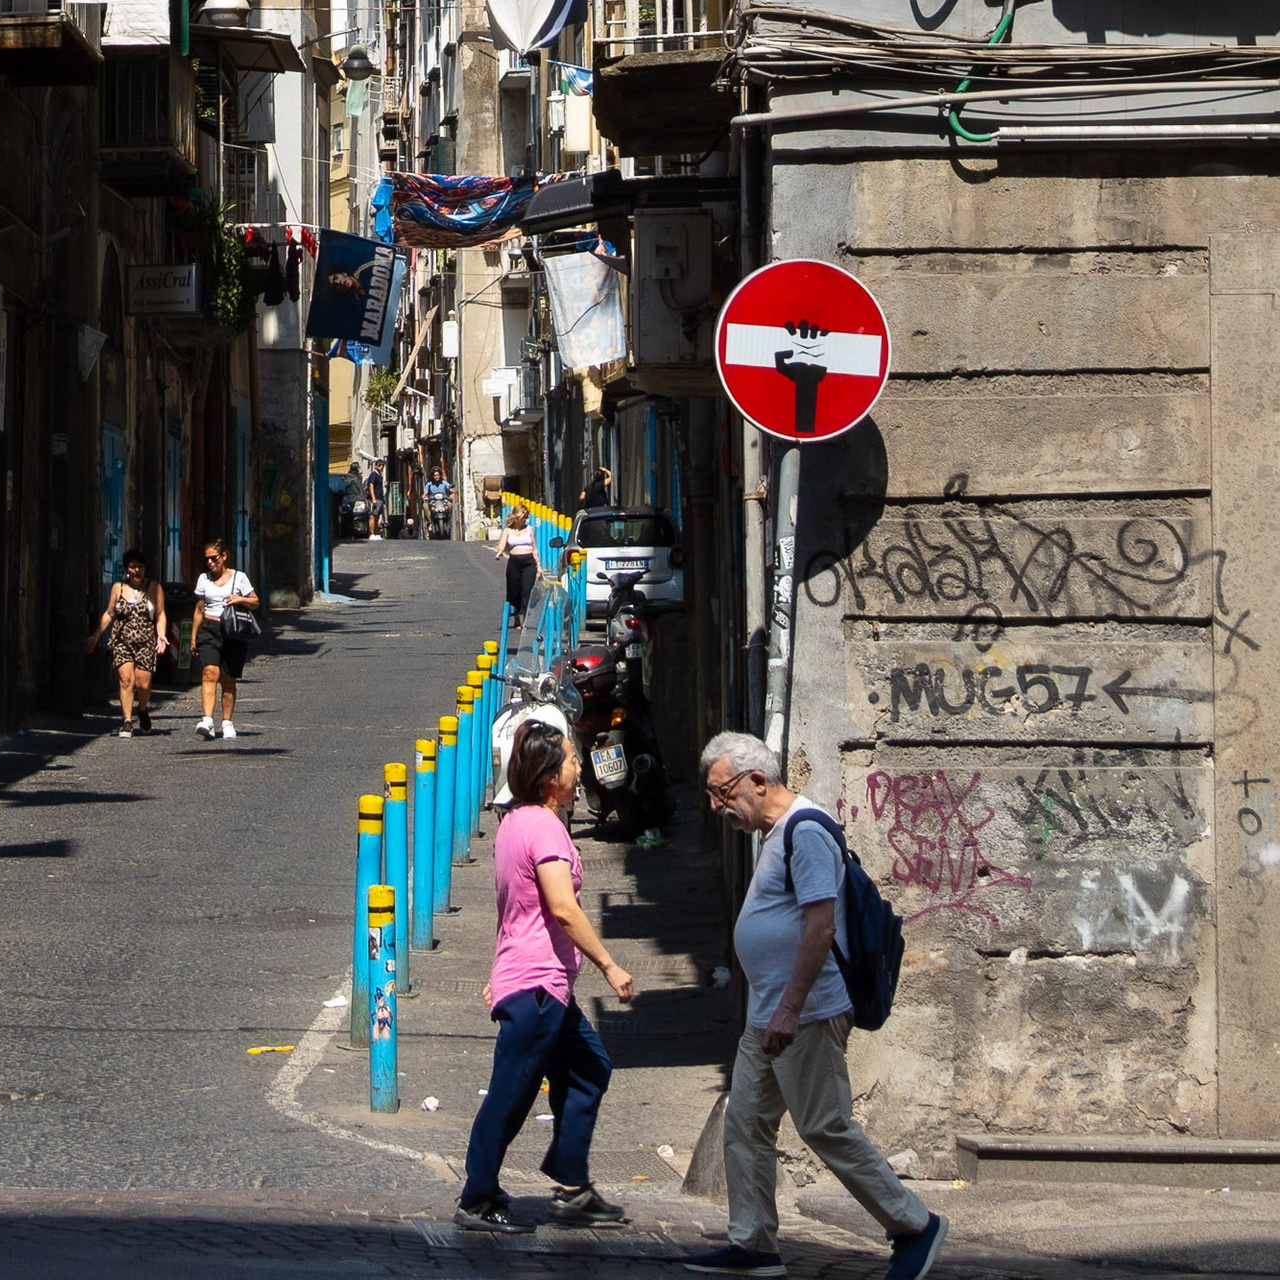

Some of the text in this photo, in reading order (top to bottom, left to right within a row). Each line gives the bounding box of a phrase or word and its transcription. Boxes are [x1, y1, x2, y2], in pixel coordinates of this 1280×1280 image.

[360, 245, 394, 341] MARADONA
[600, 748, 612, 761] EA
[598, 759, 623, 775] 10607
